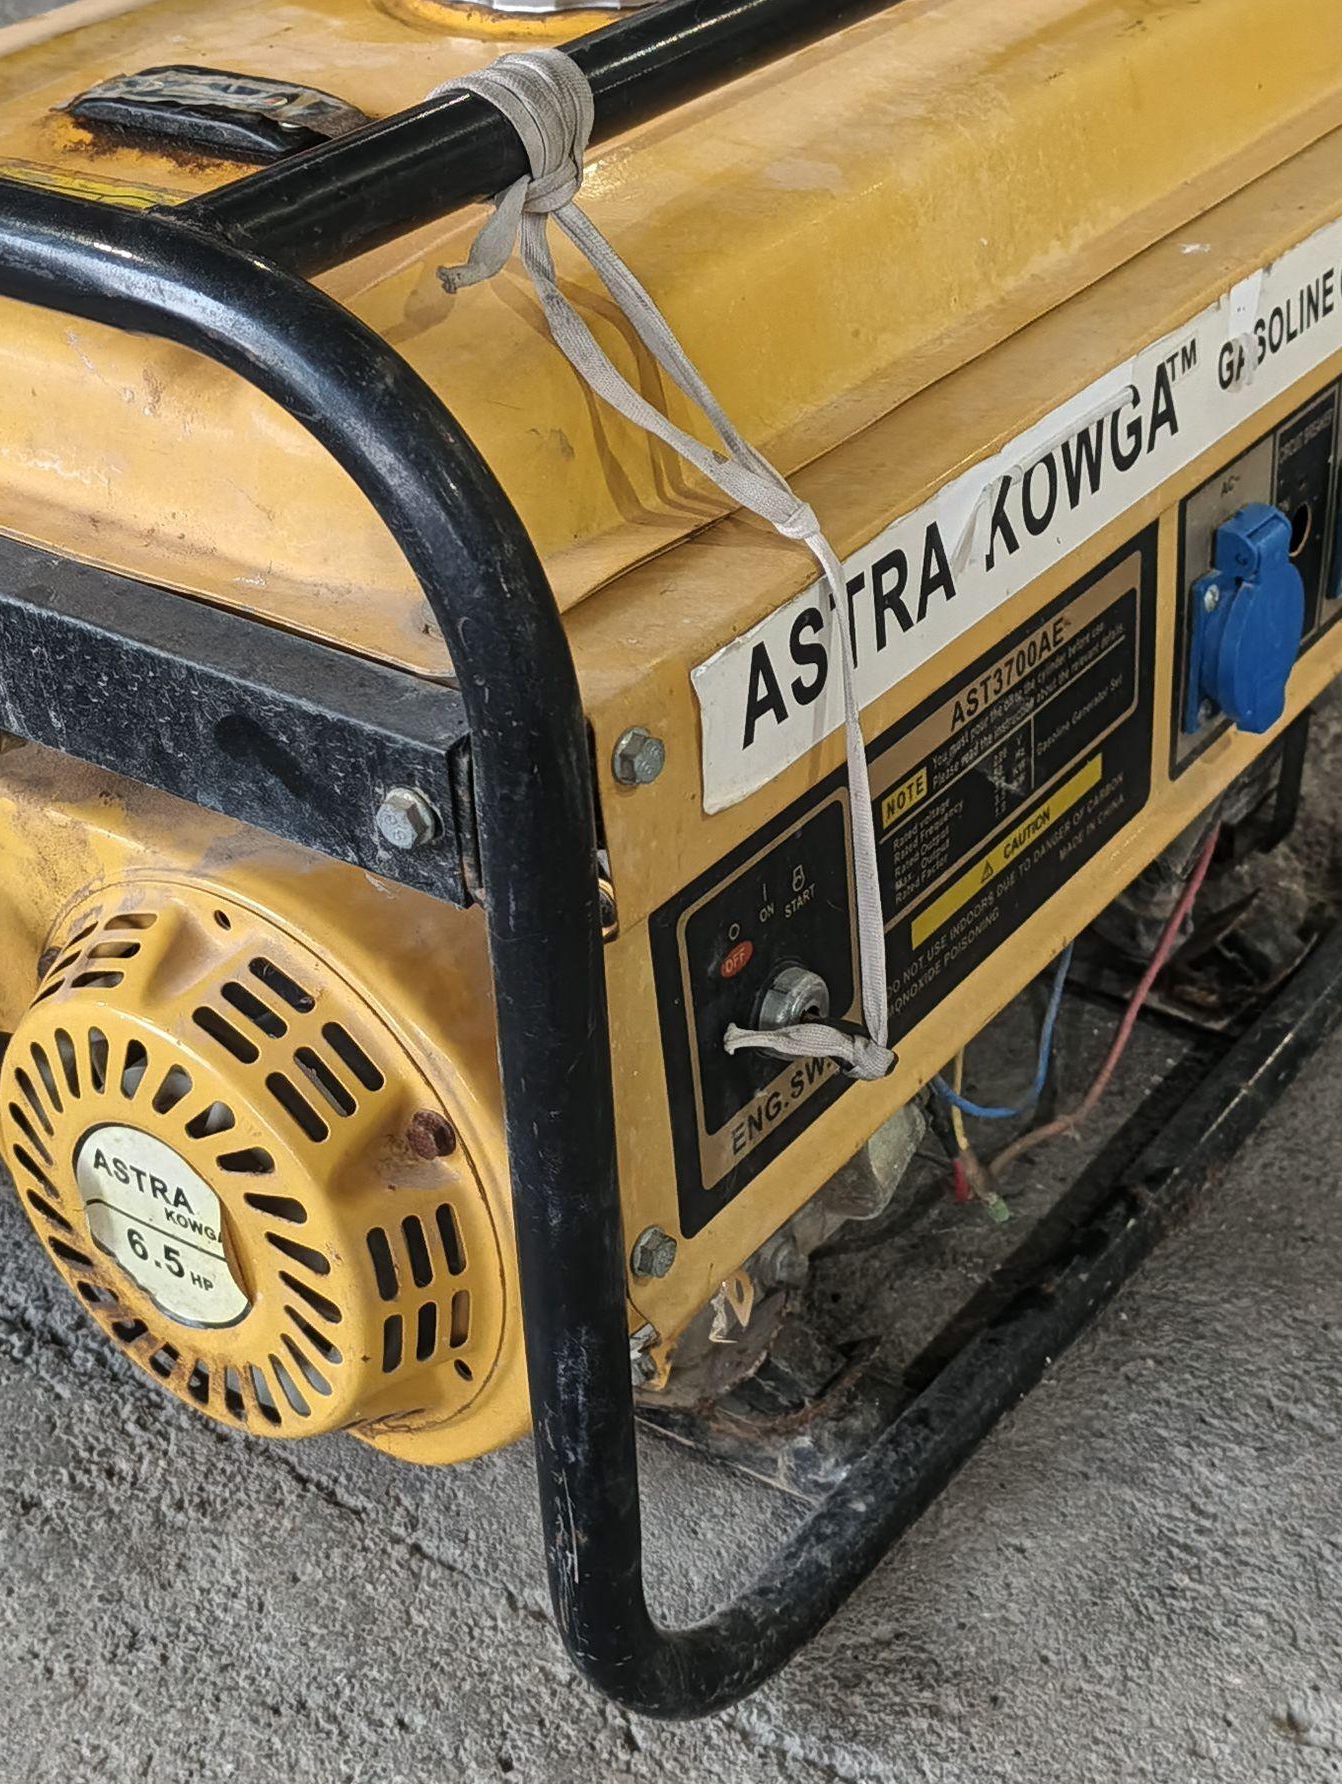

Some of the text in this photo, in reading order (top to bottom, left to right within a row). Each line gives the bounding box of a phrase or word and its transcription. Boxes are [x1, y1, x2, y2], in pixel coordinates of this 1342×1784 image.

[742, 520, 957, 751] ASTRA
[886, 776, 925, 820] NOTE
[1003, 806, 1052, 860] CAUTION
[759, 903, 775, 923] ON
[784, 883, 816, 918] START
[927, 934, 947, 961] USE
[949, 891, 995, 941] INDOORS
[997, 871, 1017, 897] DUE
[1018, 855, 1032, 877] TO
[1033, 819, 1071, 864] DANGER
[725, 949, 746, 973] OFF
[944, 906, 1000, 966] POISONING
[93, 1147, 195, 1214] ASTRA
[126, 1227, 215, 1292] 6.5 HP
